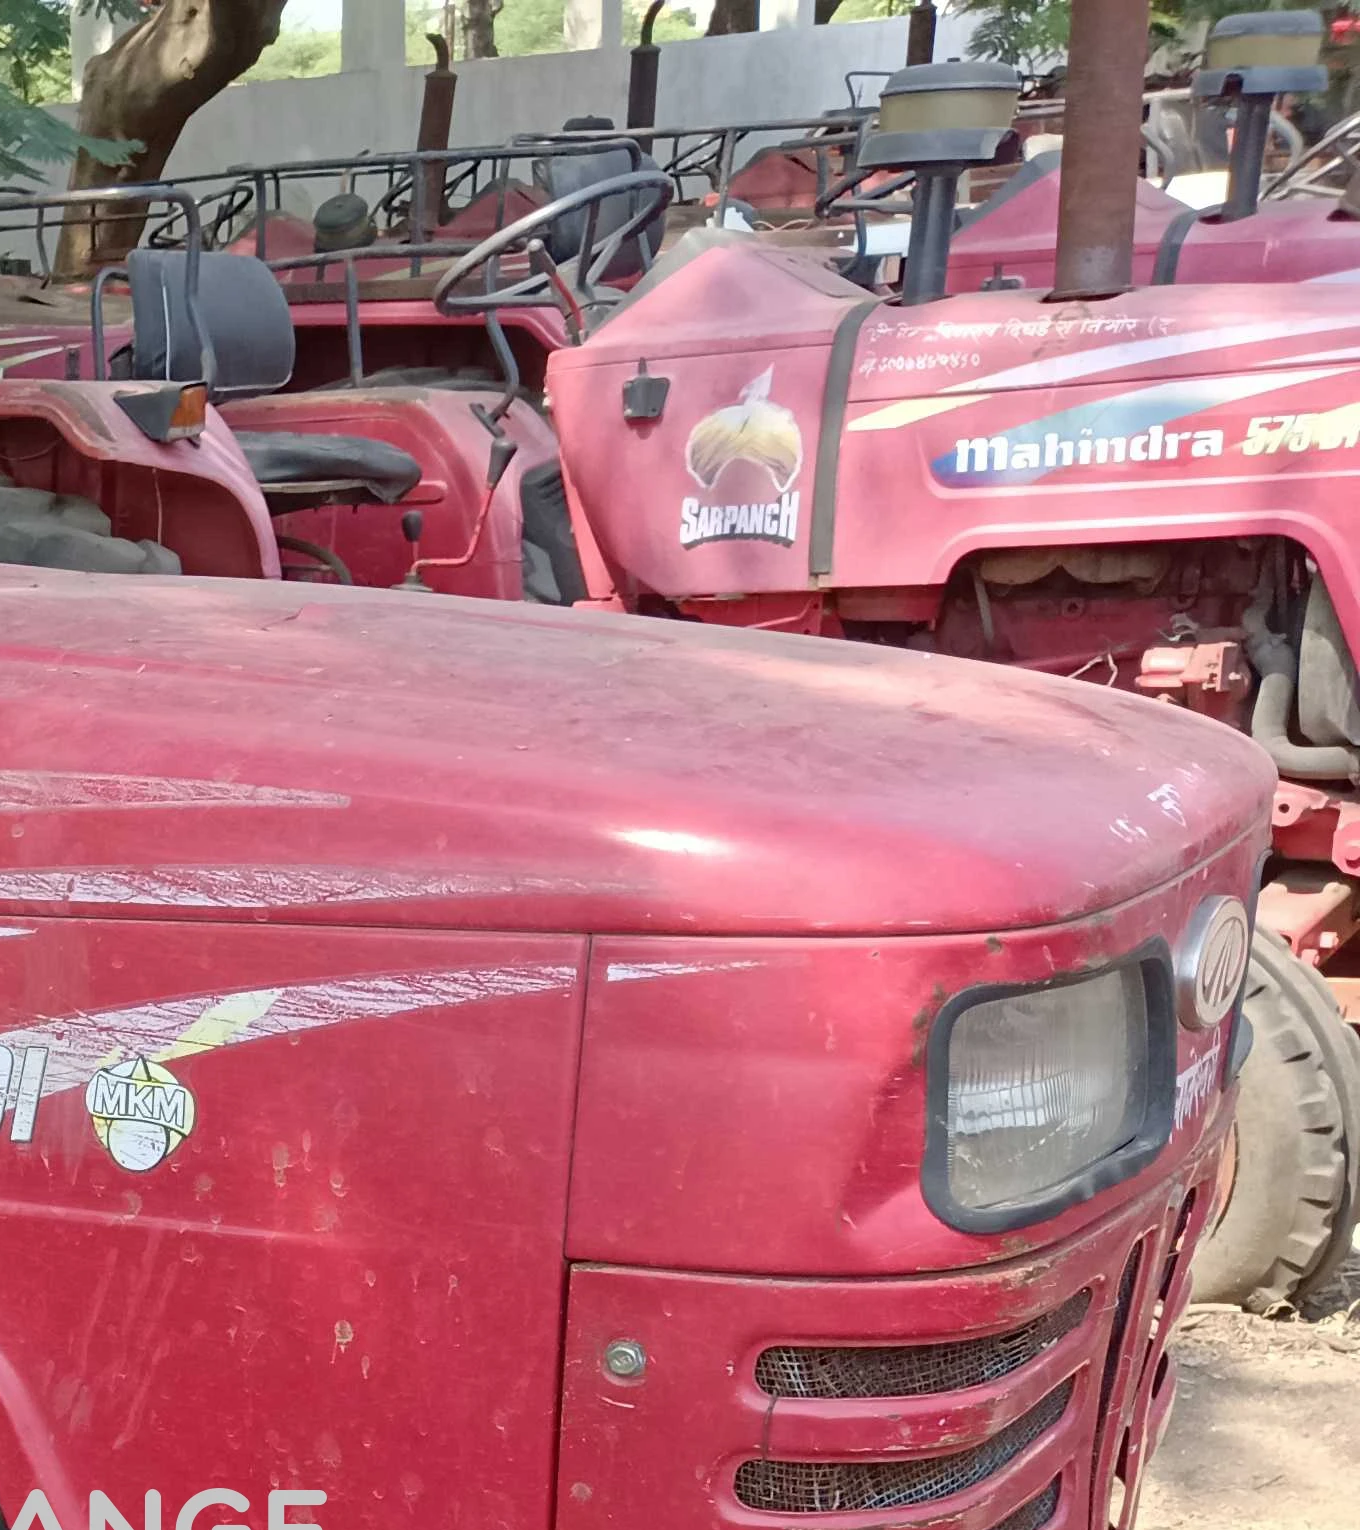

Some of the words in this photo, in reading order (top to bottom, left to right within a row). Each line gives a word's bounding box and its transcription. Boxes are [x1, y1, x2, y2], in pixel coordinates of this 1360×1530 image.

[955, 425, 1225, 473] Mahindra
[680, 490, 800, 543] SARPANCH
[86, 1076, 194, 1131] MKM
